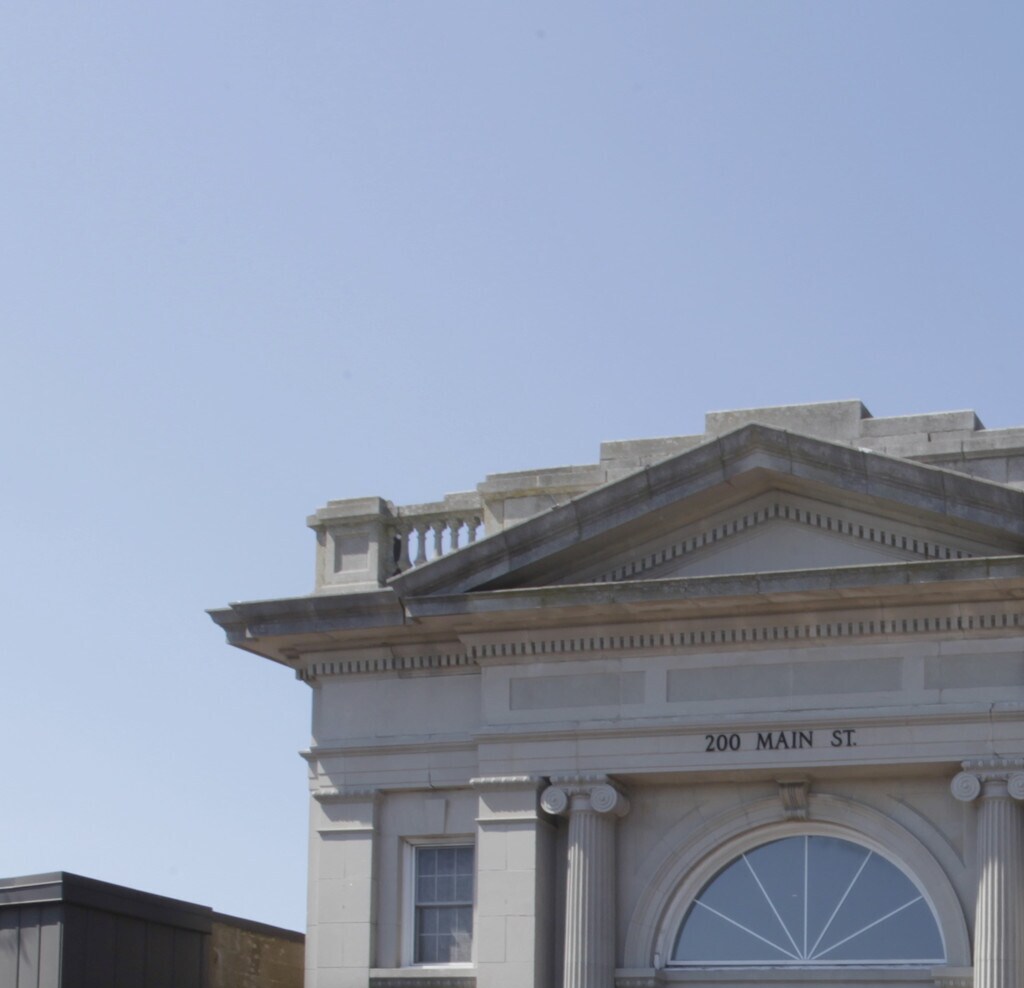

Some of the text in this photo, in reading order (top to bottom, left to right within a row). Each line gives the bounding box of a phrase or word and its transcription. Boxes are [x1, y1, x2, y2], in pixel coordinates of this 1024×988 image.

[705, 730, 856, 752] 200 MAIN ST.
